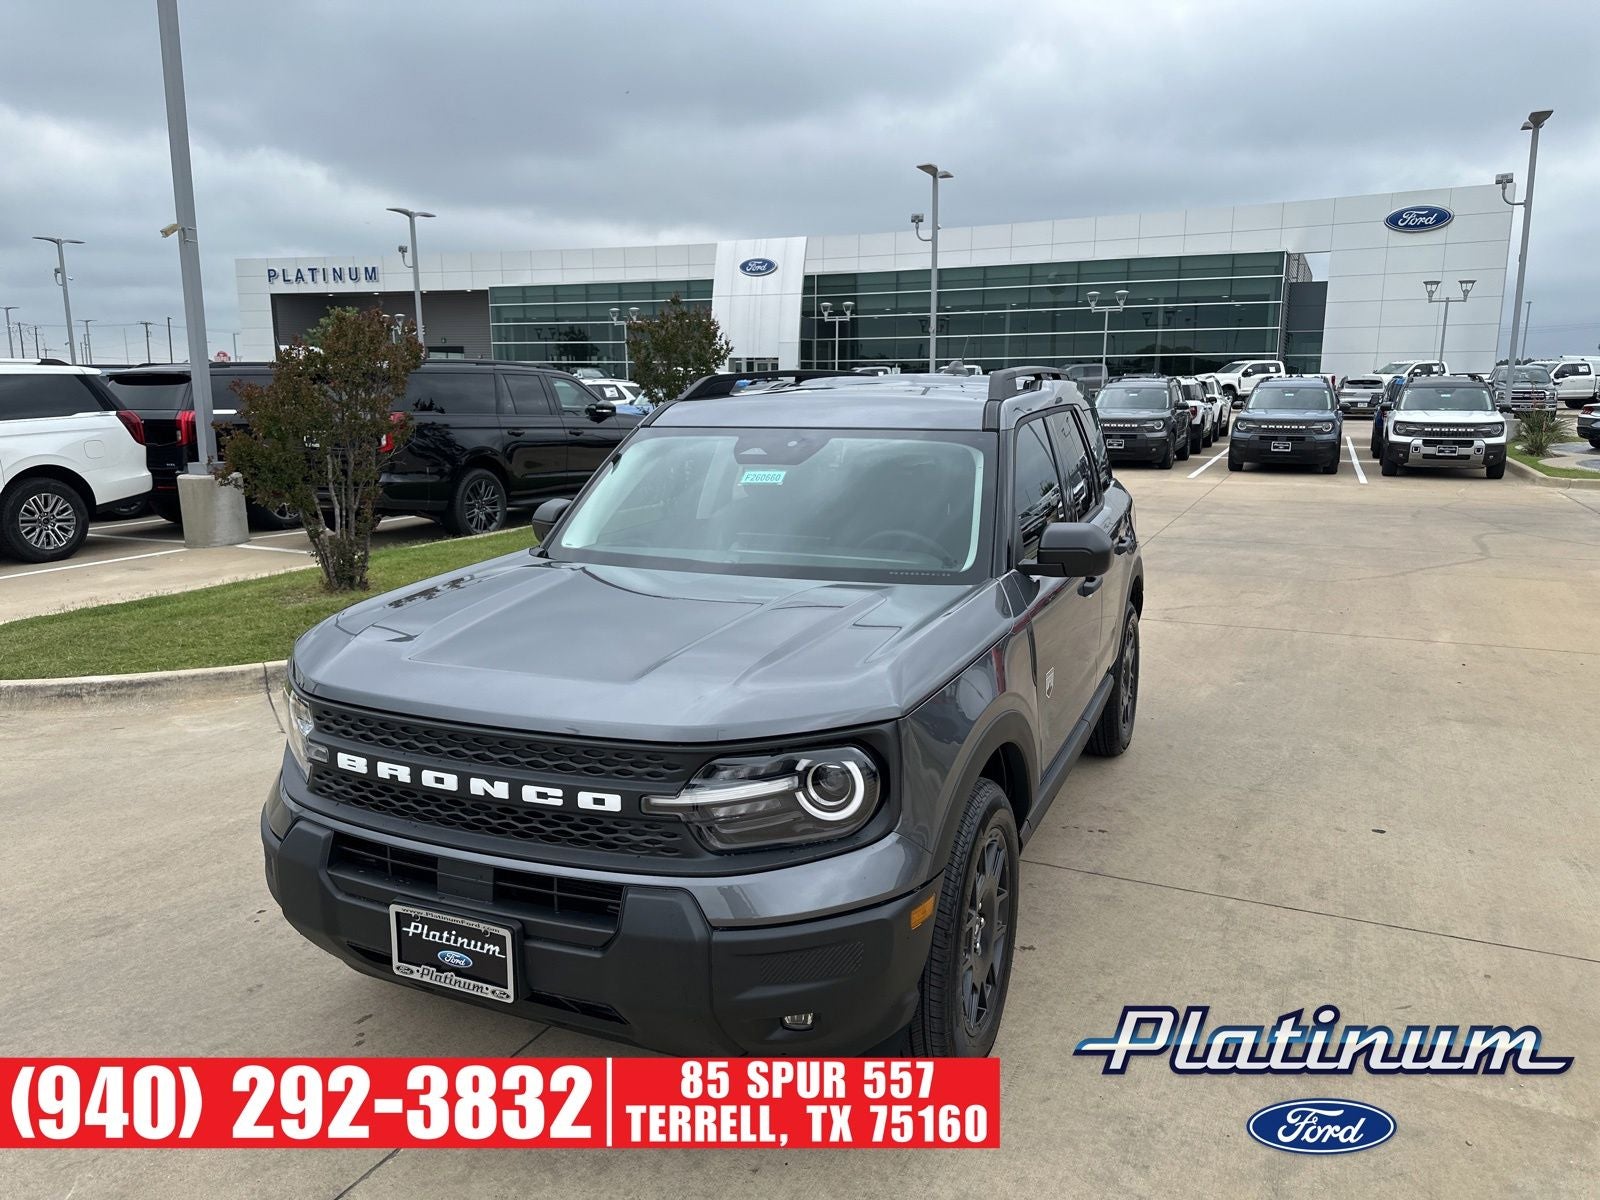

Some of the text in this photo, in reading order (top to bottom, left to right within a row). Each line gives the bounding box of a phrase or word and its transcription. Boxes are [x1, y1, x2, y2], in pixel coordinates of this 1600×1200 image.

[1398, 210, 1438, 226] Ford
[746, 260, 768, 271] Ford
[267, 266, 378, 283] PLATINUM
[744, 473, 782, 482] F260660
[336, 751, 622, 812] BRONCO
[401, 921, 506, 958] Platinum
[444, 953, 466, 967] Ford
[420, 967, 488, 994] Platinum
